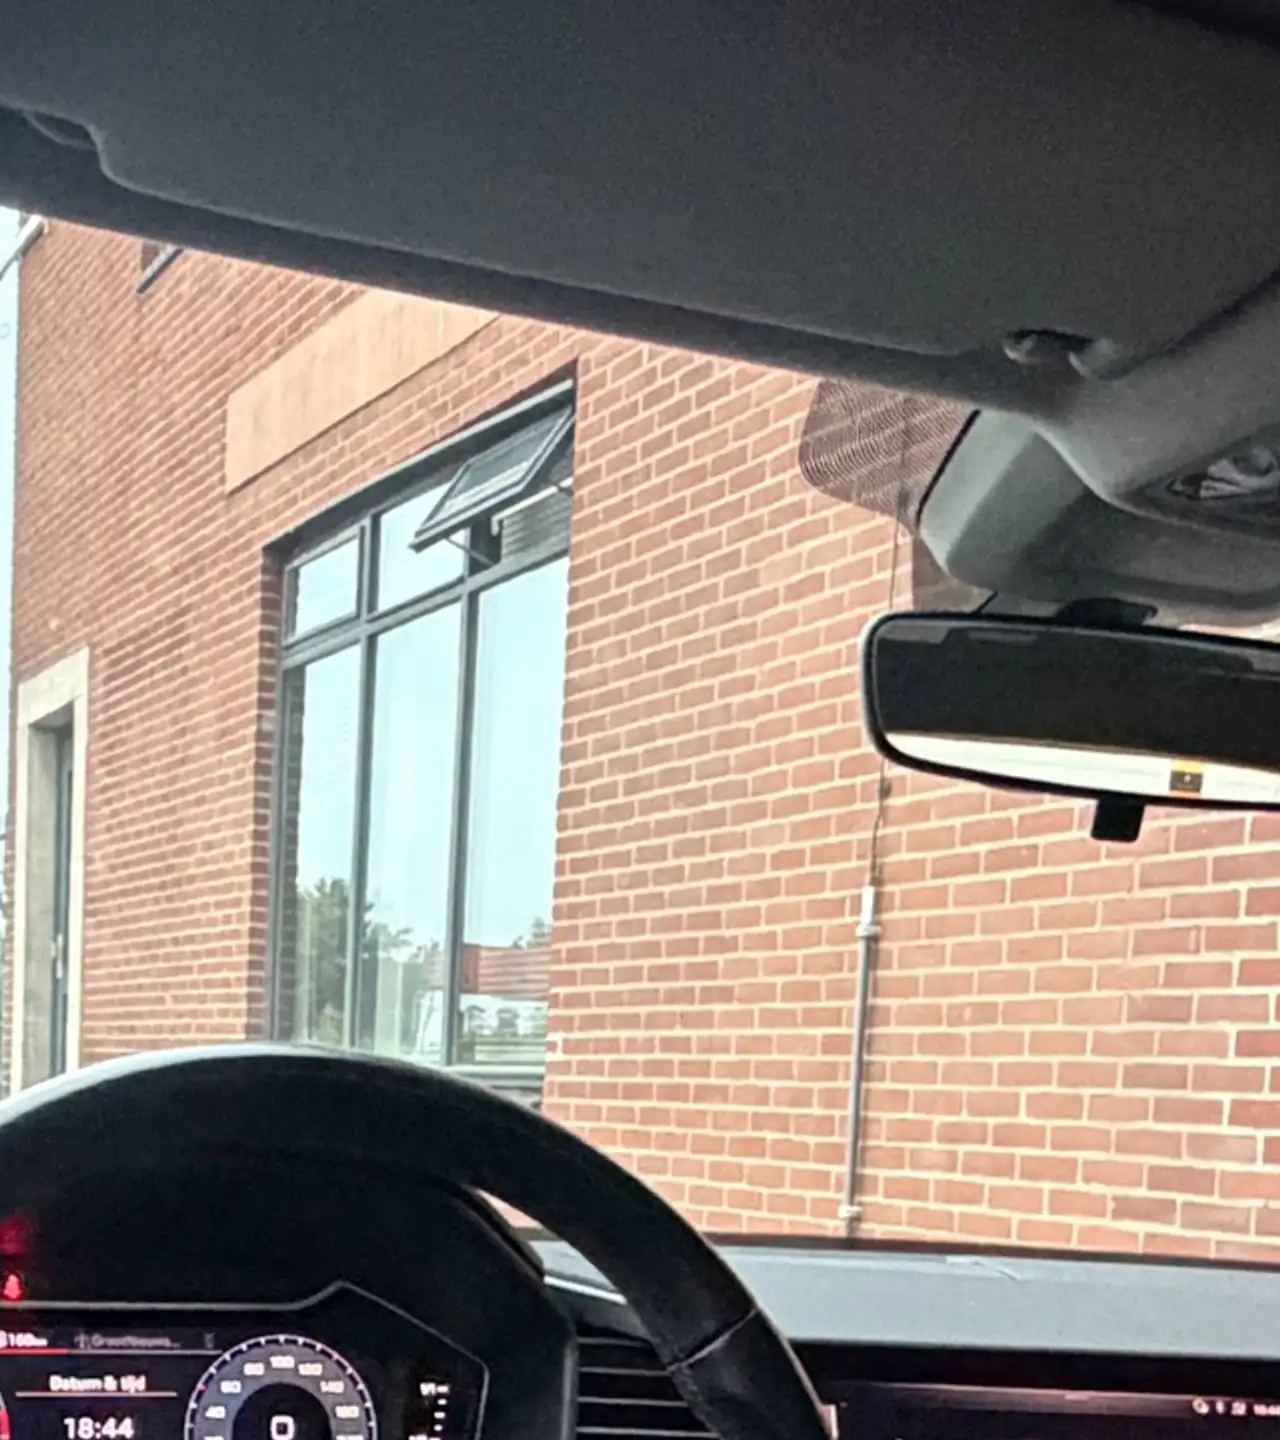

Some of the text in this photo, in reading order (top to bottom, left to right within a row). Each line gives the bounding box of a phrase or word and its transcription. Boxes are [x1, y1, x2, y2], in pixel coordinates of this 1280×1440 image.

[50, 1375, 101, 1391] Datum
[121, 1375, 146, 1394] tijd
[64, 1417, 135, 1440] 18:44
